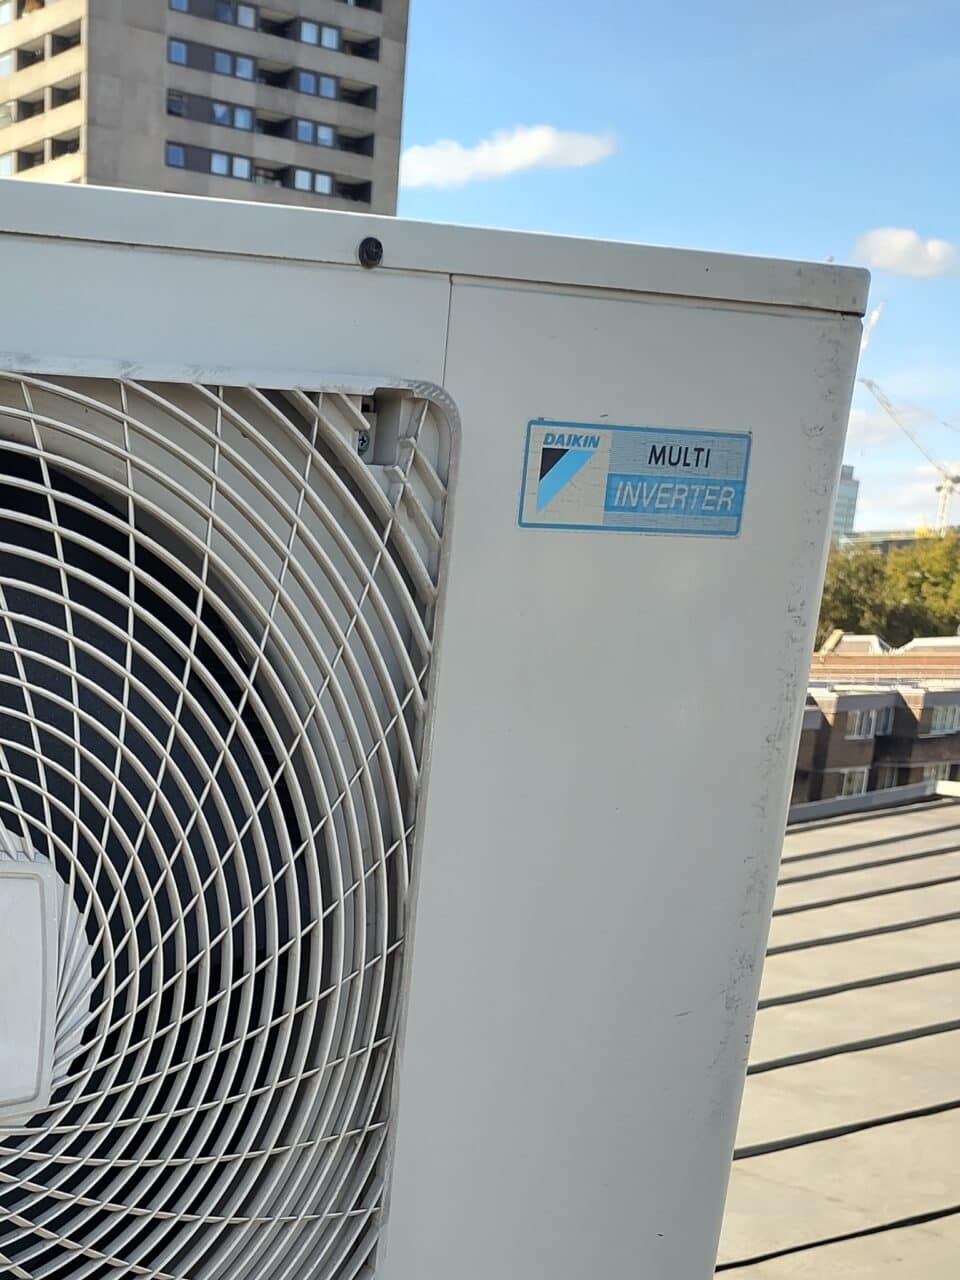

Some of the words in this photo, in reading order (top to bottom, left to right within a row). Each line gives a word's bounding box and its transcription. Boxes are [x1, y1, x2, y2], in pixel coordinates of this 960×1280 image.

[543, 432, 600, 449] DAIKIN
[648, 445, 711, 468] MULTI
[613, 480, 736, 511] INVERTER
